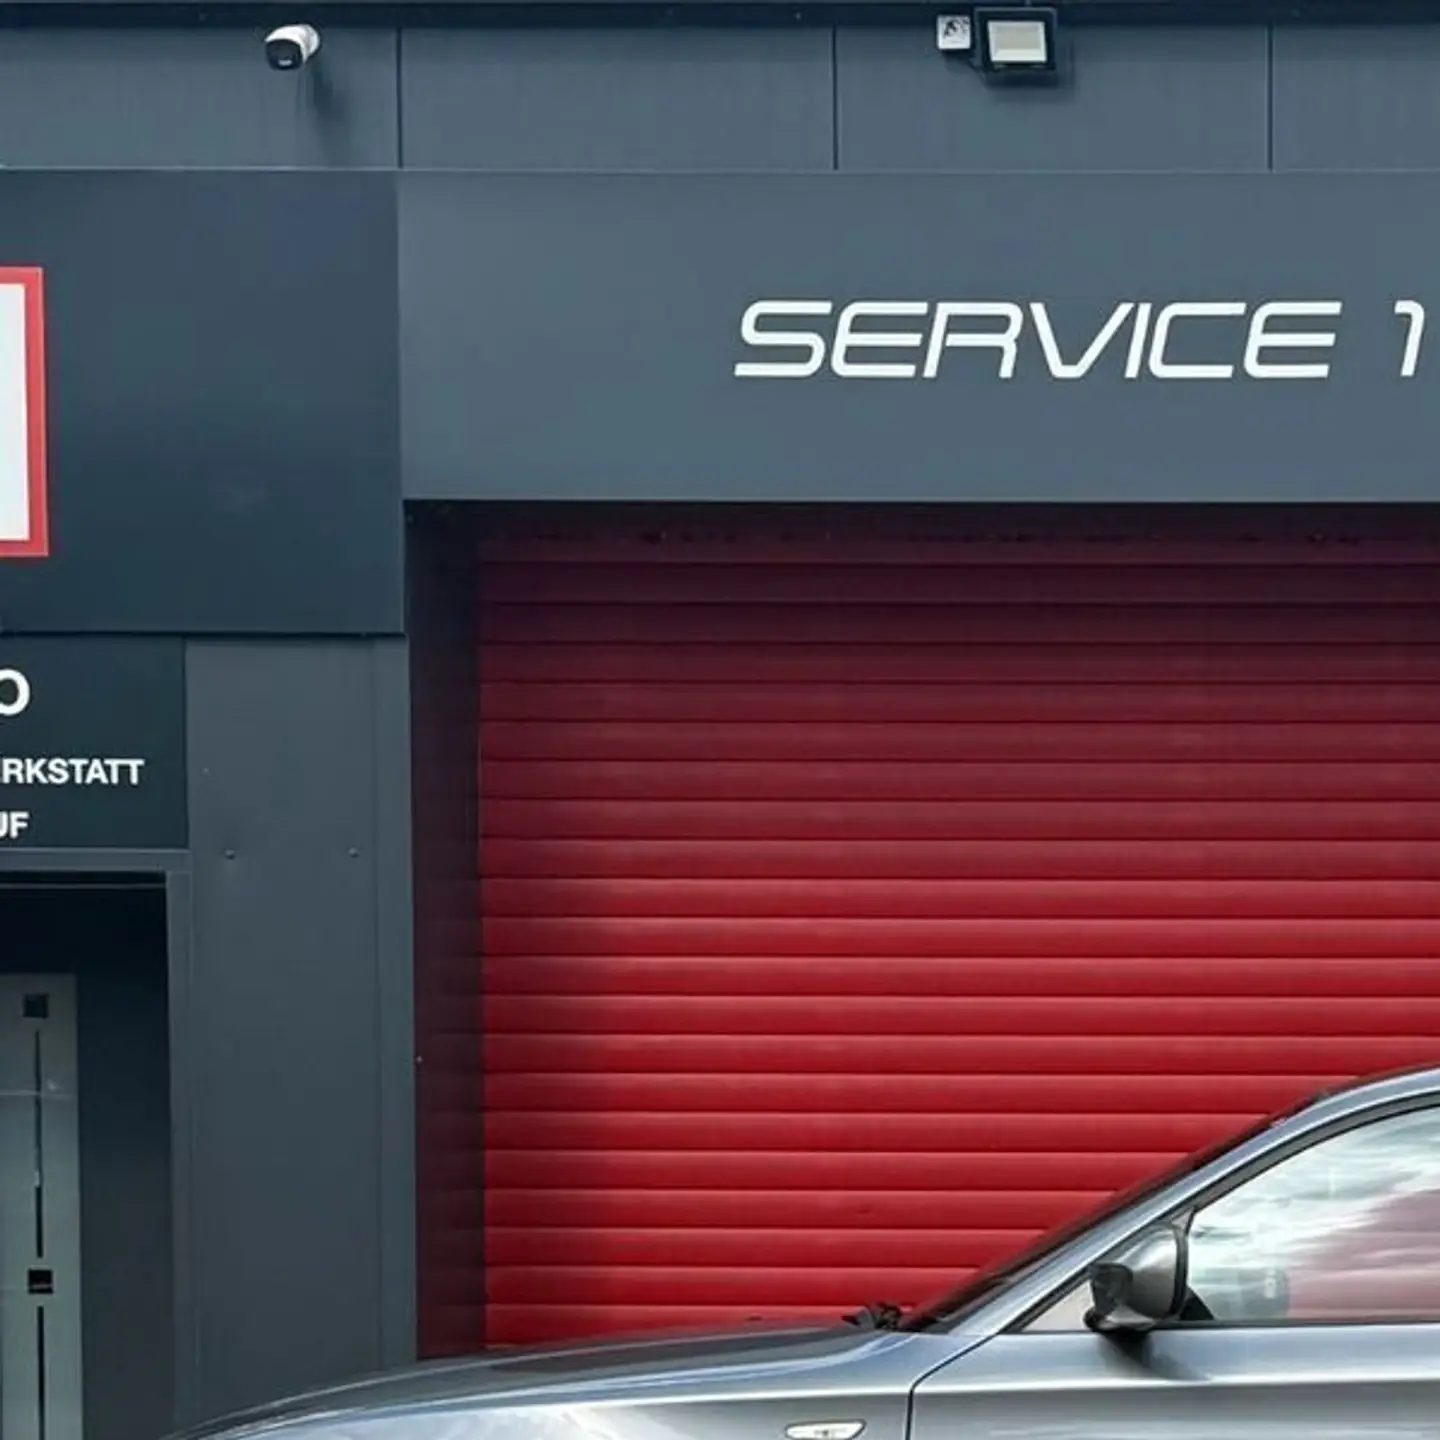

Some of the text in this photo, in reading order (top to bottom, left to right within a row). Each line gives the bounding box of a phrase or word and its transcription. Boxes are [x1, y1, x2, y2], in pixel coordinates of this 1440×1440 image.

[734, 299, 1425, 379] SERVICE 1
[0, 757, 146, 785] RKSTATT
